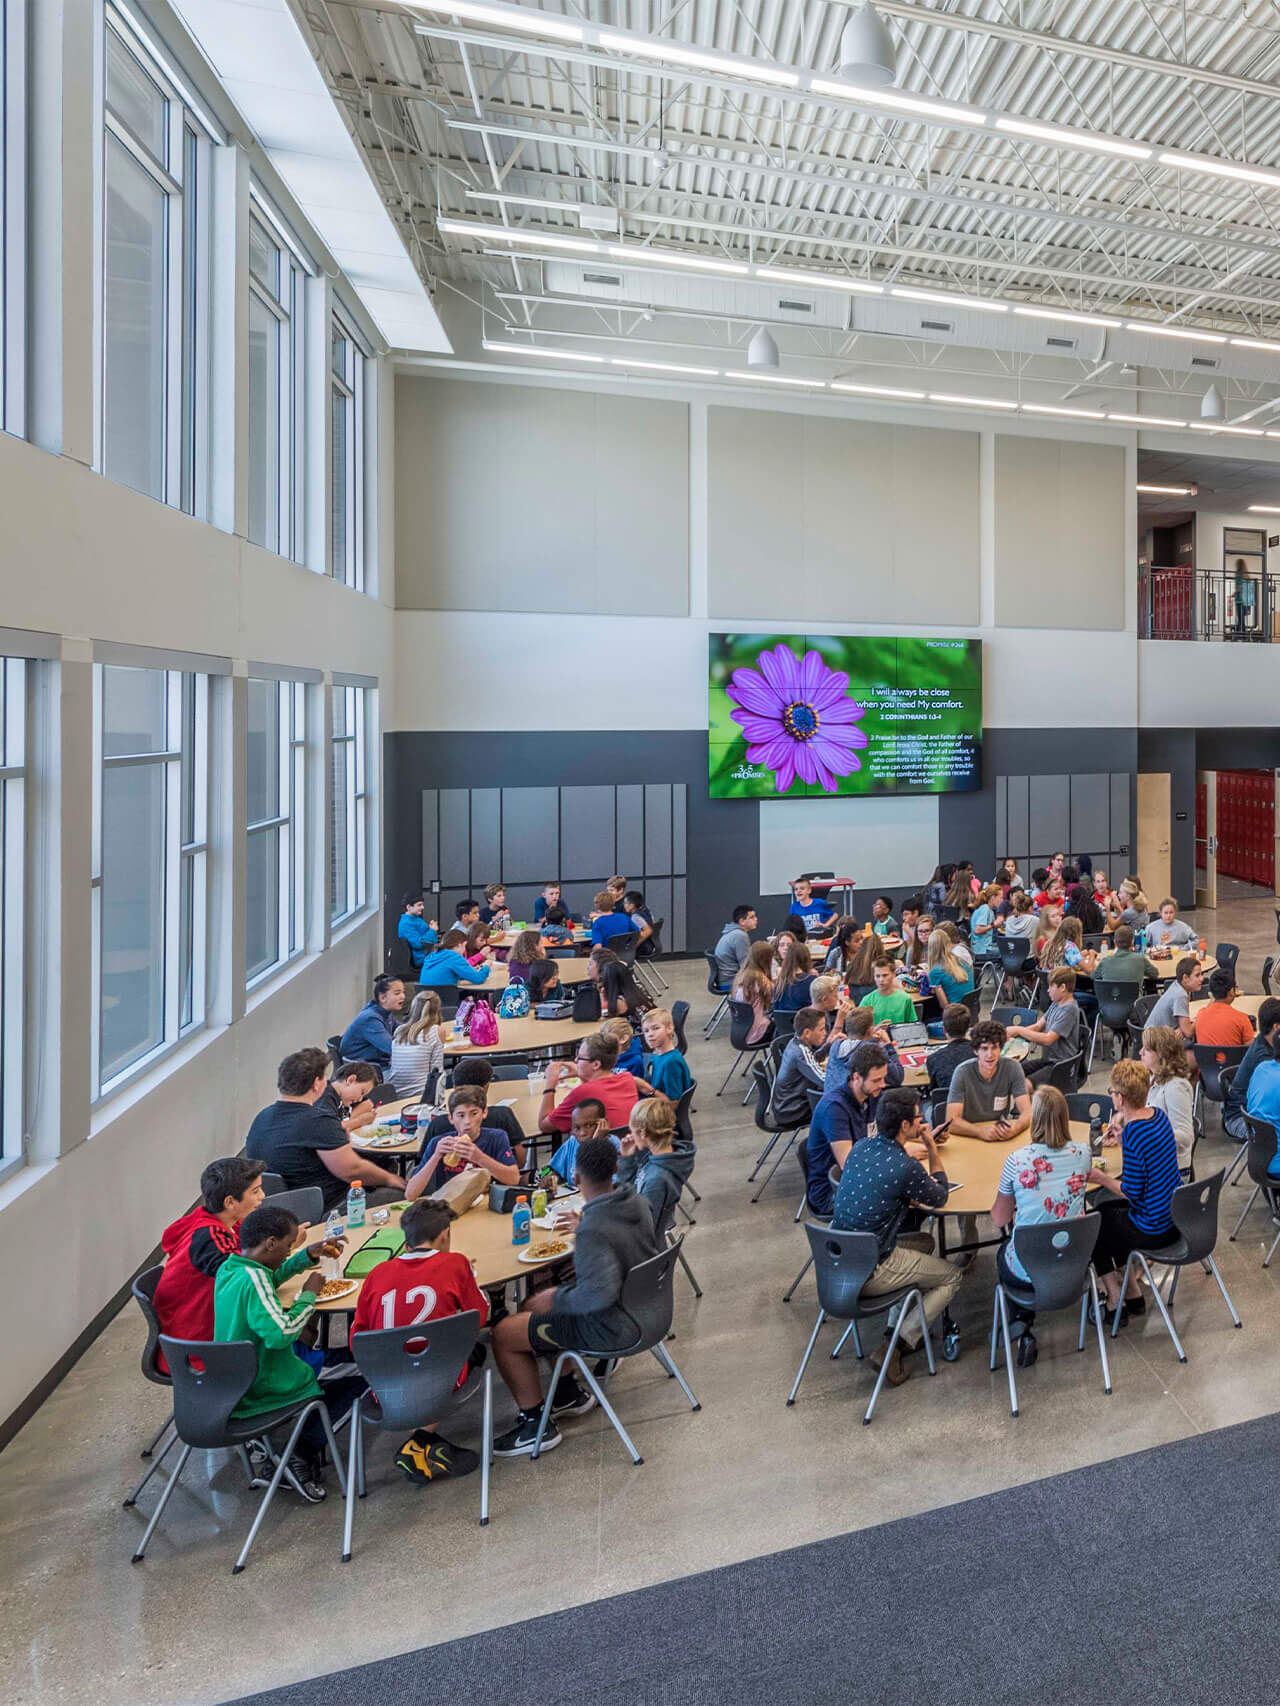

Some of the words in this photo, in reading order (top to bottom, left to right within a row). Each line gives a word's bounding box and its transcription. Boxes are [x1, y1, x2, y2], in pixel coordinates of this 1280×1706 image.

[876, 688, 890, 696] will
[892, 688, 917, 698] always
[918, 688, 929, 696] be
[930, 688, 950, 697] close
[856, 700, 878, 708] when
[880, 702, 895, 710] you
[897, 700, 916, 708] need
[917, 700, 930, 710] My
[931, 700, 964, 709] comfort.
[381, 1285, 437, 1329] 12
